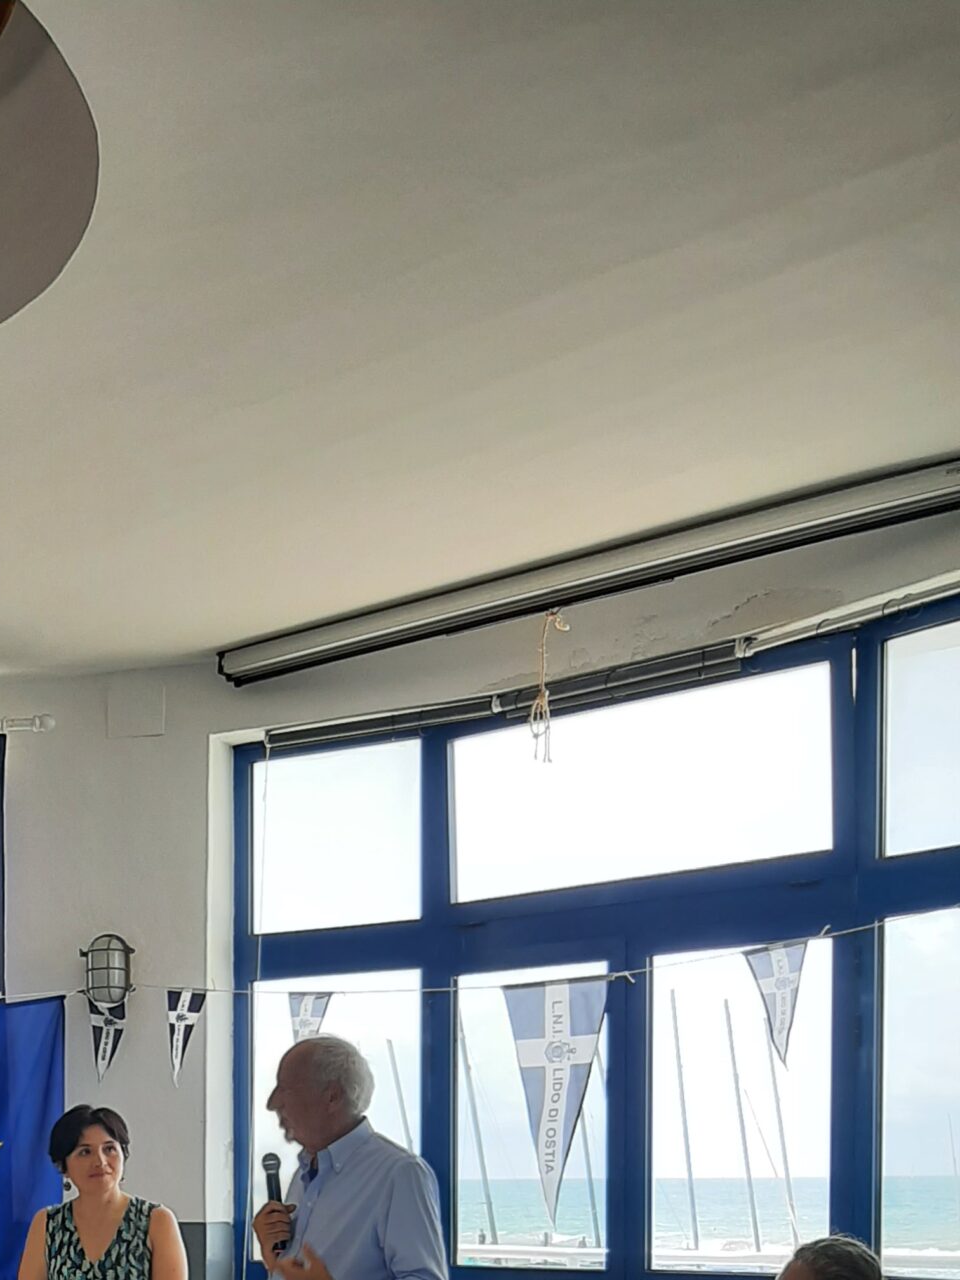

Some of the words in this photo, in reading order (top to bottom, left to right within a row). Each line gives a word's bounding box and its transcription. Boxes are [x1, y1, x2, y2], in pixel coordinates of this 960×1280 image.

[550, 1067, 565, 1104] LIDO
[547, 1108, 559, 1123] DI
[544, 1127, 557, 1175] OSTIA
